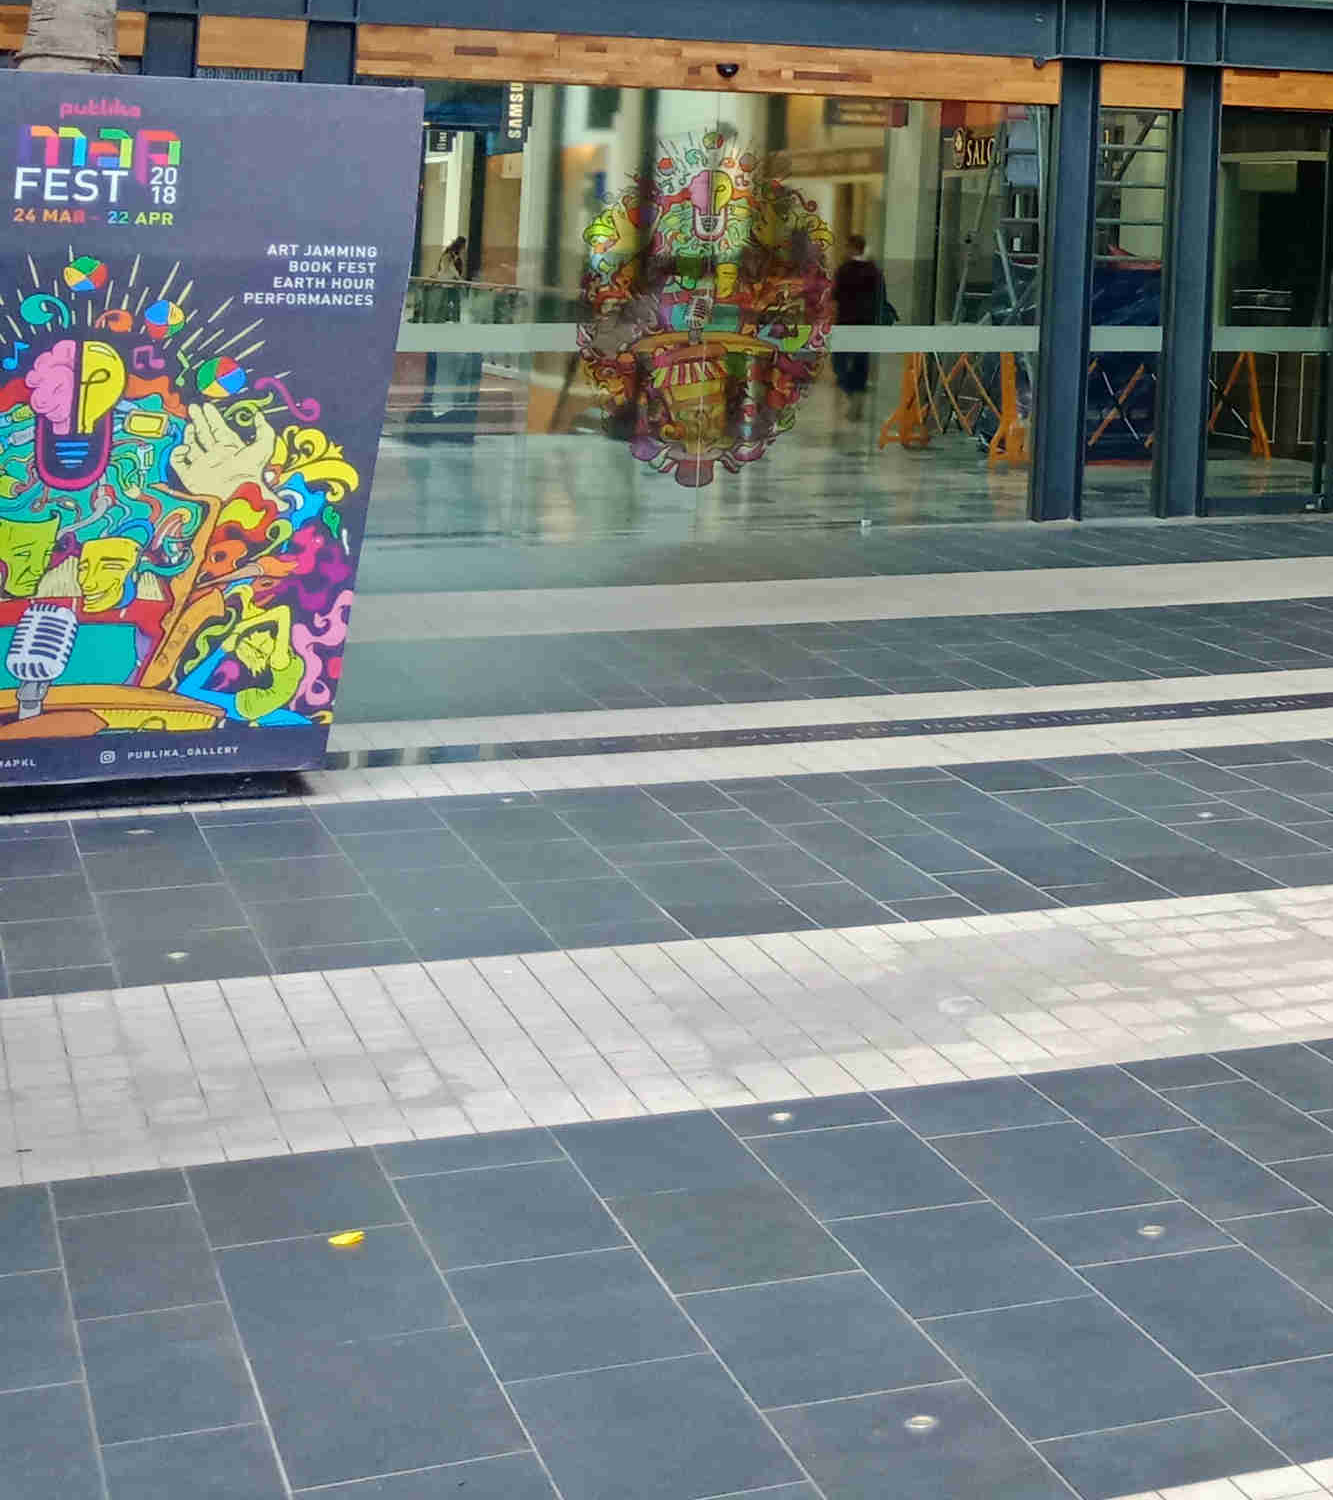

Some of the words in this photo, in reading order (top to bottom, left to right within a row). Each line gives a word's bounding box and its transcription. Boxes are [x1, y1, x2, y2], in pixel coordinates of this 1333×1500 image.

[59, 99, 142, 120] publika
[507, 82, 524, 140] SAMSU
[14, 166, 129, 203] FEST
[150, 166, 178, 185] 20
[151, 186, 177, 204] 18
[107, 210, 129, 225] 22
[134, 211, 174, 226] APR
[267, 244, 299, 256] ART
[304, 244, 378, 258] JAMMING
[289, 261, 332, 273] BOOK
[338, 262, 377, 274] FEST
[273, 276, 325, 289] EARTH
[331, 278, 375, 290] HOUR
[244, 292, 374, 306] PERFORMANCES
